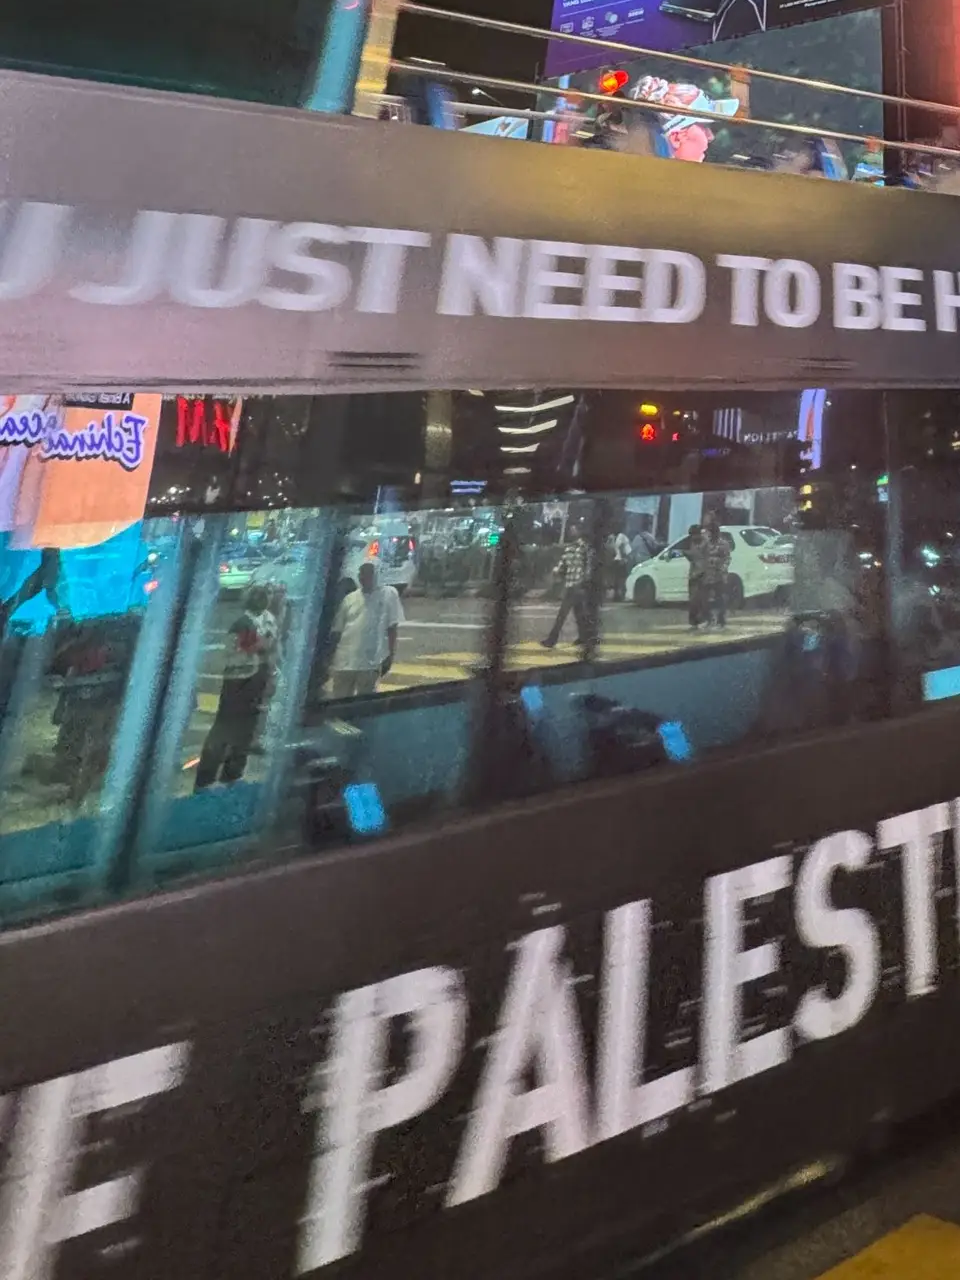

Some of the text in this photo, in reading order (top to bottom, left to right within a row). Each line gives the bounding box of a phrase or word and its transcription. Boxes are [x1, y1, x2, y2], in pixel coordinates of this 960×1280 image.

[69, 209, 432, 314] JUST
[437, 233, 706, 324] NEED
[716, 253, 819, 328] TO
[832, 262, 927, 333] BE
